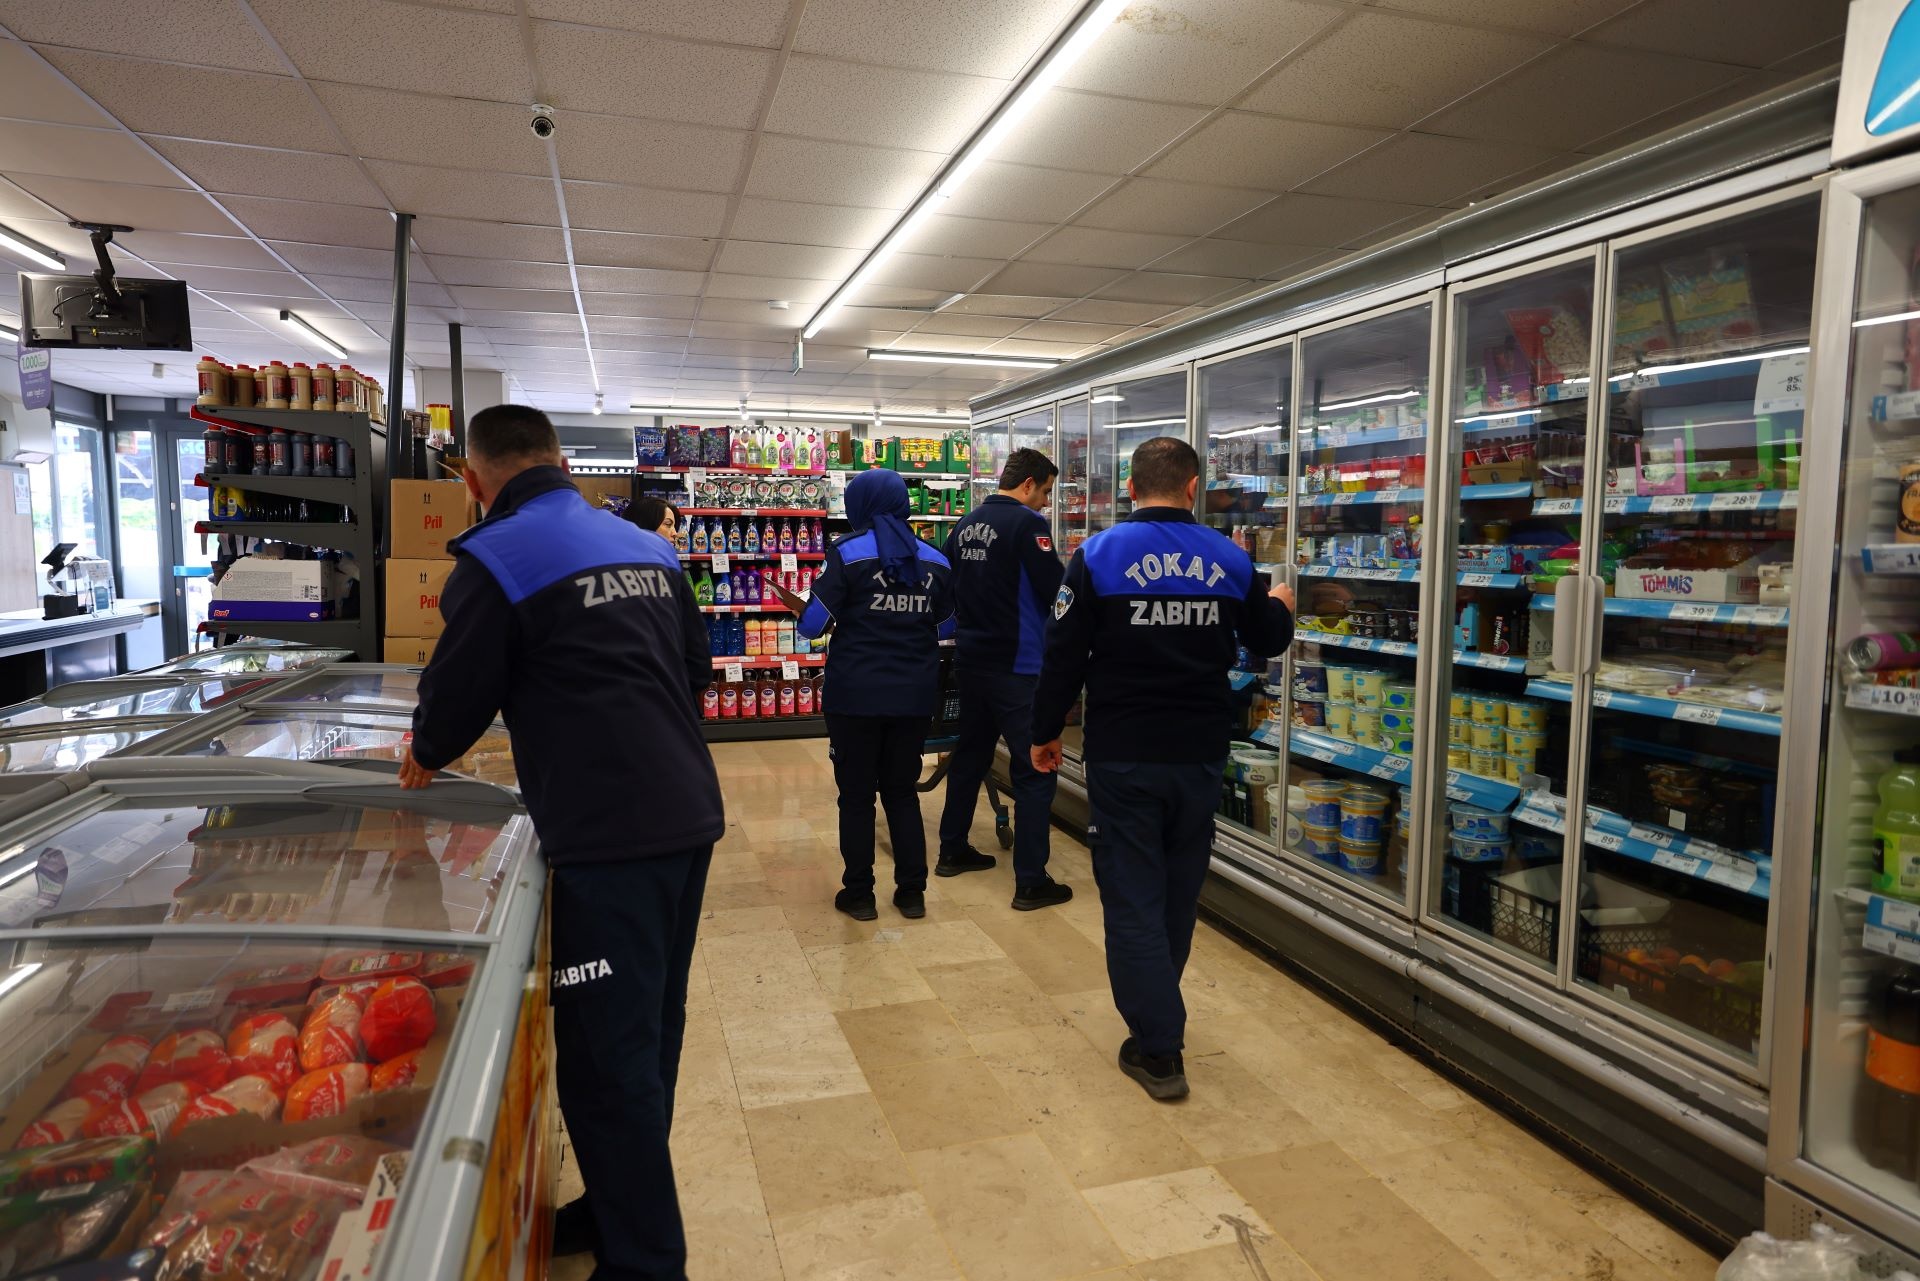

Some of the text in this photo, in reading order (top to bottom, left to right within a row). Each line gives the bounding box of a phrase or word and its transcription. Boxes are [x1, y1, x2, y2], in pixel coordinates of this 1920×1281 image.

[424, 515, 443, 529] Pril
[958, 522, 998, 548] TOKAT
[1125, 552, 1226, 588] TOKAT
[575, 569, 673, 608] ZABITA
[420, 594, 439, 609] Pril
[1129, 600, 1220, 625] ZABITA
[1883, 690, 1906, 705] 10
[1600, 836, 1614, 845] 89
[1650, 830, 1664, 841] 79
